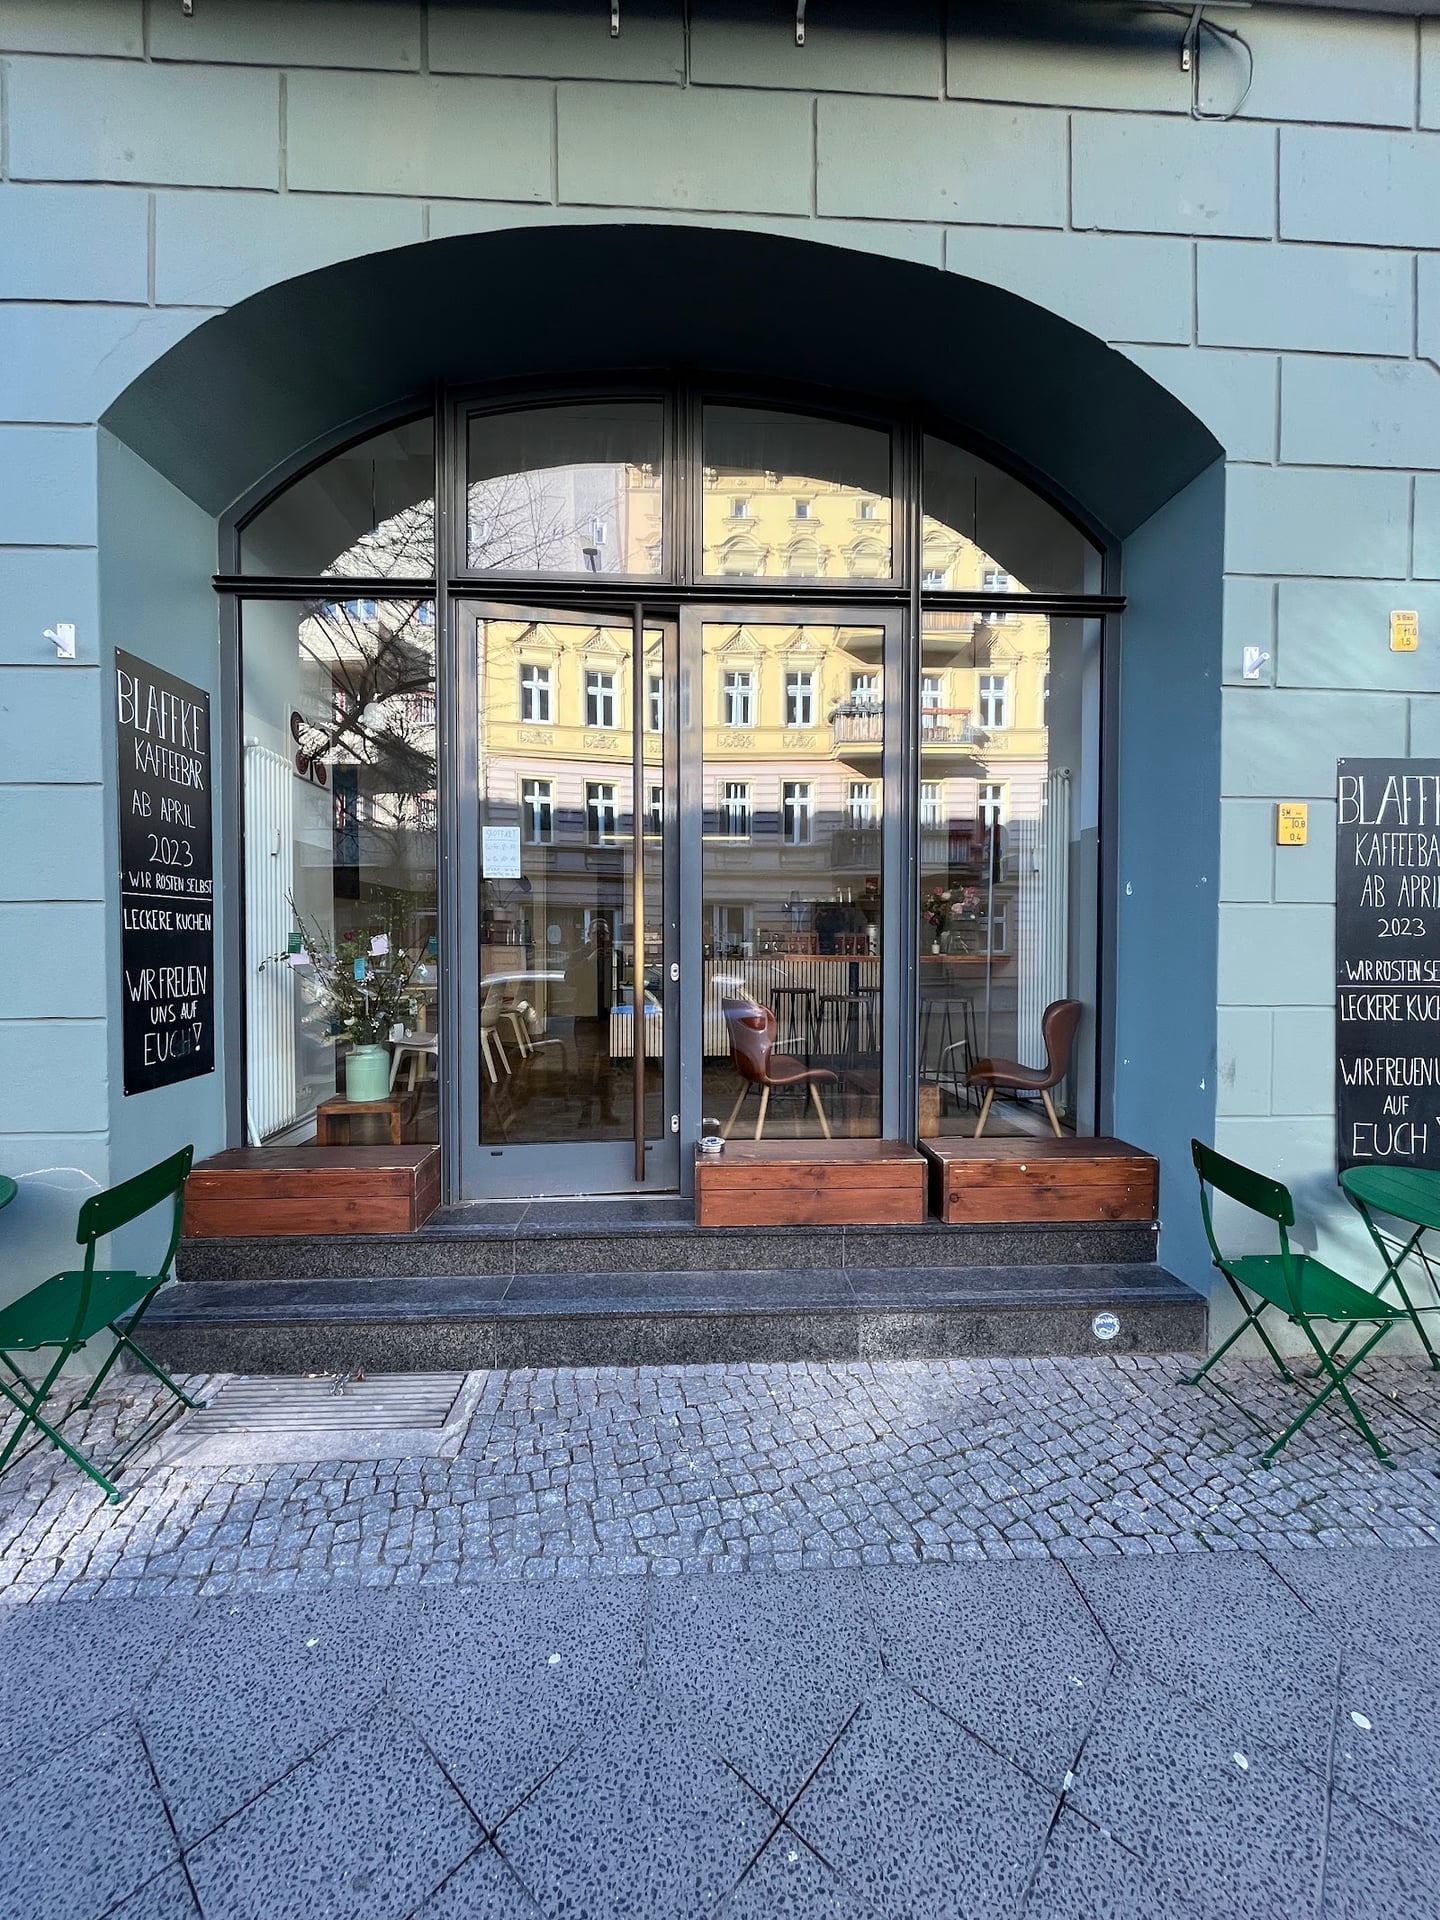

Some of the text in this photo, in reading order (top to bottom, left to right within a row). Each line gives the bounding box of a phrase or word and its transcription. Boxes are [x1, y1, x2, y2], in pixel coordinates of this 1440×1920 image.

[117, 668, 206, 755] BLAFFKE
[134, 736, 204, 791] KAFFEEBAR
[132, 789, 196, 829] AB APRIL
[147, 833, 194, 867] 2023
[128, 871, 152, 889] WIR
[186, 878, 213, 894] SELBST
[1360, 874, 1385, 908] AB
[124, 908, 211, 931] LECKERE KUCHEN
[1377, 917, 1426, 938] 2023
[126, 965, 206, 1002] WIR FREUEN
[1345, 960, 1373, 981] WIR
[150, 1000, 198, 1025] UNS AUF
[1340, 994, 1403, 1021] LECKERE
[1340, 1057, 1375, 1086] WIR
[1376, 1057, 1433, 1086] FREUEN
[1383, 1095, 1410, 1116] AUF
